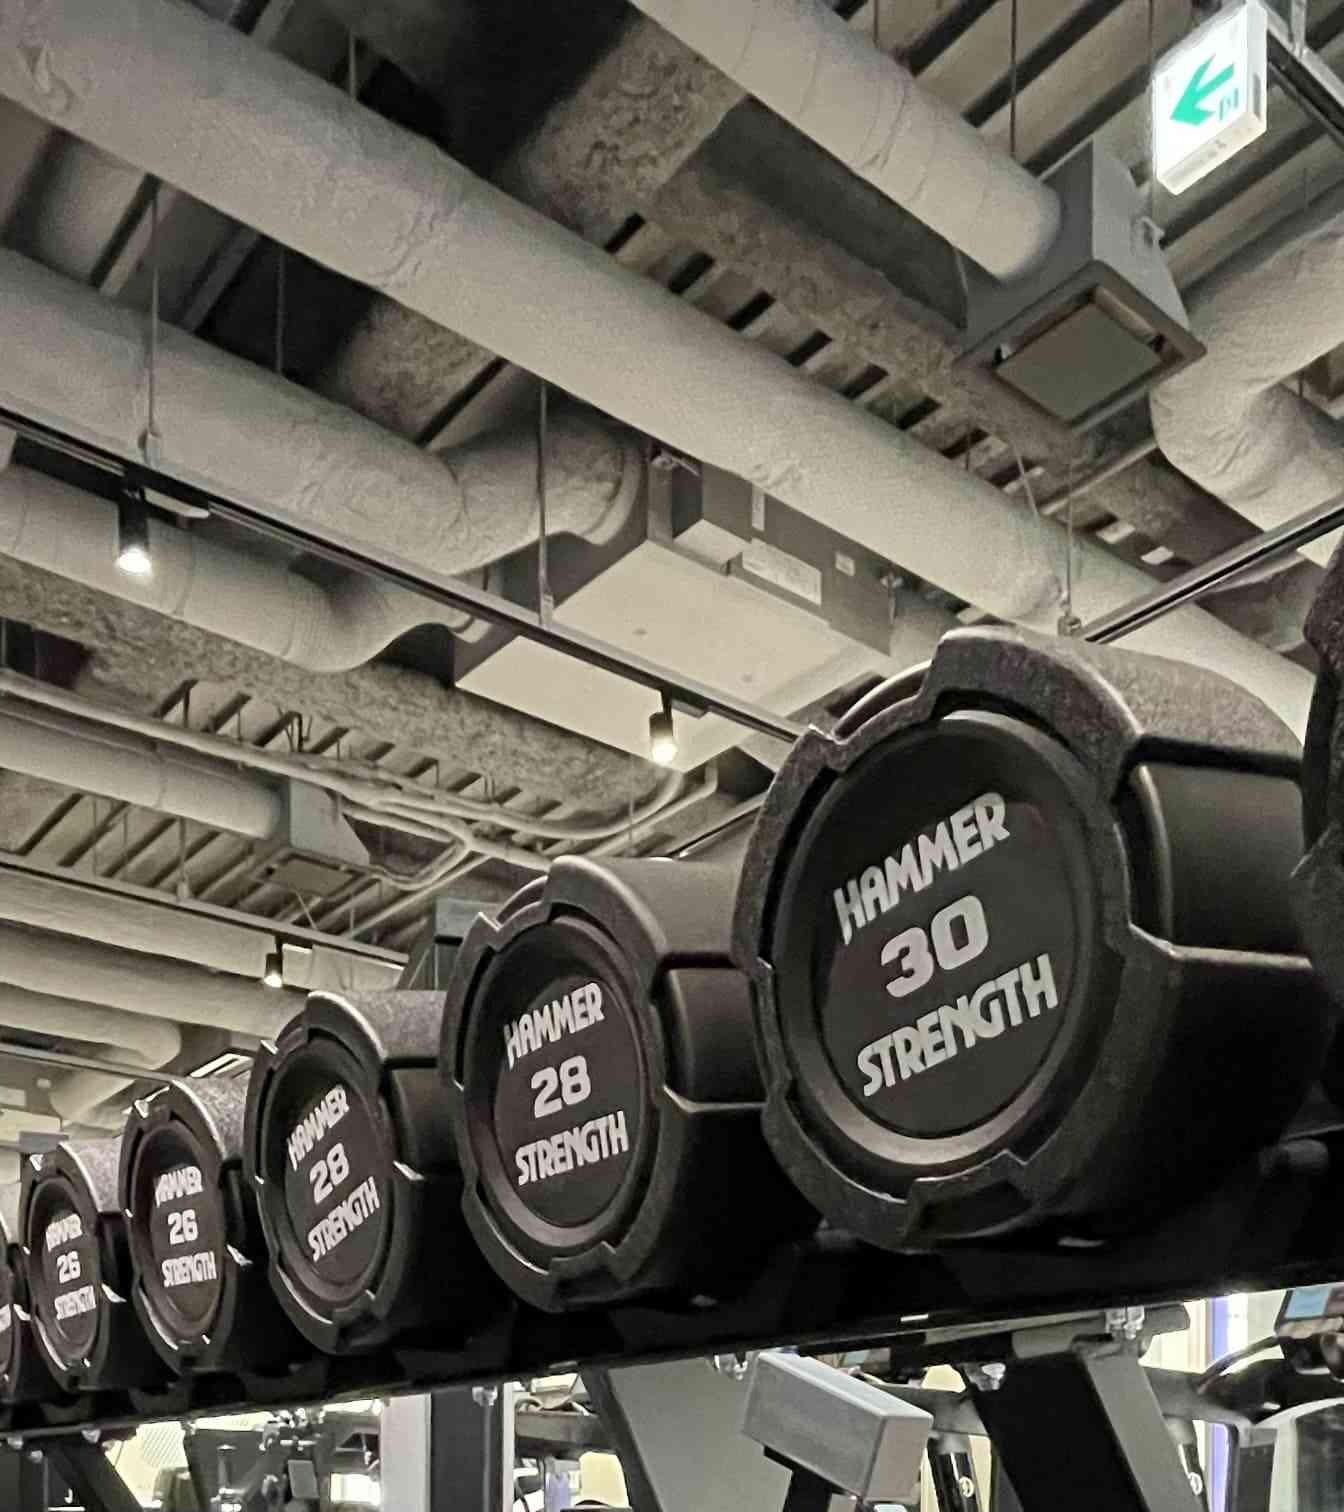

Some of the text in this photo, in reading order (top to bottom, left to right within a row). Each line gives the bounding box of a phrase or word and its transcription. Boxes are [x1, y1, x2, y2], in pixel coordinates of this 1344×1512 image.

[832, 791, 1011, 946] HAMMER
[878, 894, 990, 999] 30
[503, 981, 606, 1072] HAMMER
[856, 952, 1060, 1098] STRENGTH
[286, 1083, 350, 1172] HAMMER
[530, 1054, 592, 1119] 28
[309, 1142, 351, 1204] 28
[514, 1109, 630, 1187] STRENGTH
[167, 1208, 199, 1245] 26
[307, 1175, 381, 1262] STRENGTH
[56, 1250, 81, 1284] 26
